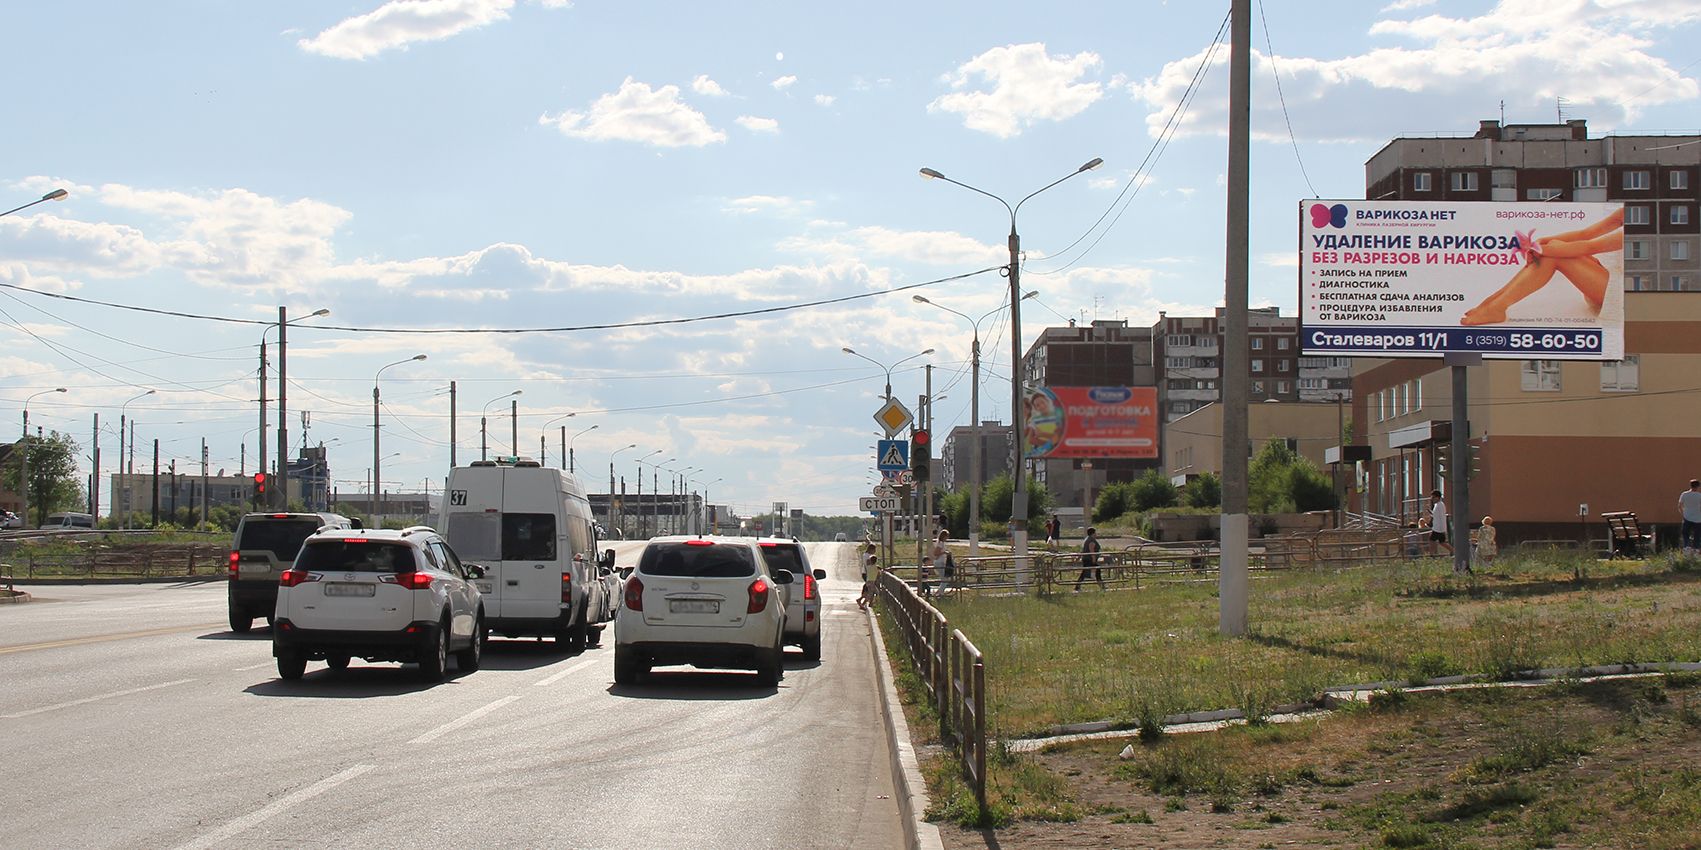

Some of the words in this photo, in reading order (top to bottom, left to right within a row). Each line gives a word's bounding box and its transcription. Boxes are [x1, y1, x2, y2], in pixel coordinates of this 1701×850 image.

[1356, 210, 1428, 220] ВАРИКОЗА
[1430, 210, 1457, 220] НЕТ
[1496, 210, 1586, 220] варикоза-нет.рф
[1312, 234, 1411, 250] УДАЛЕНИЕ
[1418, 235, 1521, 250] ВАРИКОЗА
[1312, 251, 1338, 264] БЕЗ
[1343, 252, 1420, 265] РАЗРЕЗОВ
[1426, 253, 1438, 265] И
[1444, 253, 1520, 266] НАРКОЗА
[1319, 269, 1356, 277] ЗАПИСЬ
[1374, 270, 1408, 278] ПРИЕМ
[1319, 281, 1390, 289] ДИАГНОСТИКА
[1319, 293, 1377, 301] БЕСПЛАТНАЯ
[1379, 293, 1411, 302] СДАЧА
[1413, 294, 1465, 302] АНАЛИЗОВ
[1319, 304, 1377, 313] ПРОЦЕДУРА
[1379, 305, 1443, 313] ИЗБАВЛЕНИЯ
[1319, 313, 1331, 321] ОТ
[1334, 313, 1386, 321] ВАРИКОЗА
[1312, 331, 1415, 349] Сталеваров
[1418, 333, 1448, 350] 11/1
[1465, 336, 1473, 344] 8
[1476, 335, 1507, 346] (3519)
[1510, 334, 1599, 349] 58-60-50
[1068, 406, 1151, 417] ПОДГОТОВКА
[902, 474, 914, 483] 30
[452, 490, 467, 505] 37
[865, 499, 895, 509] СТОП
